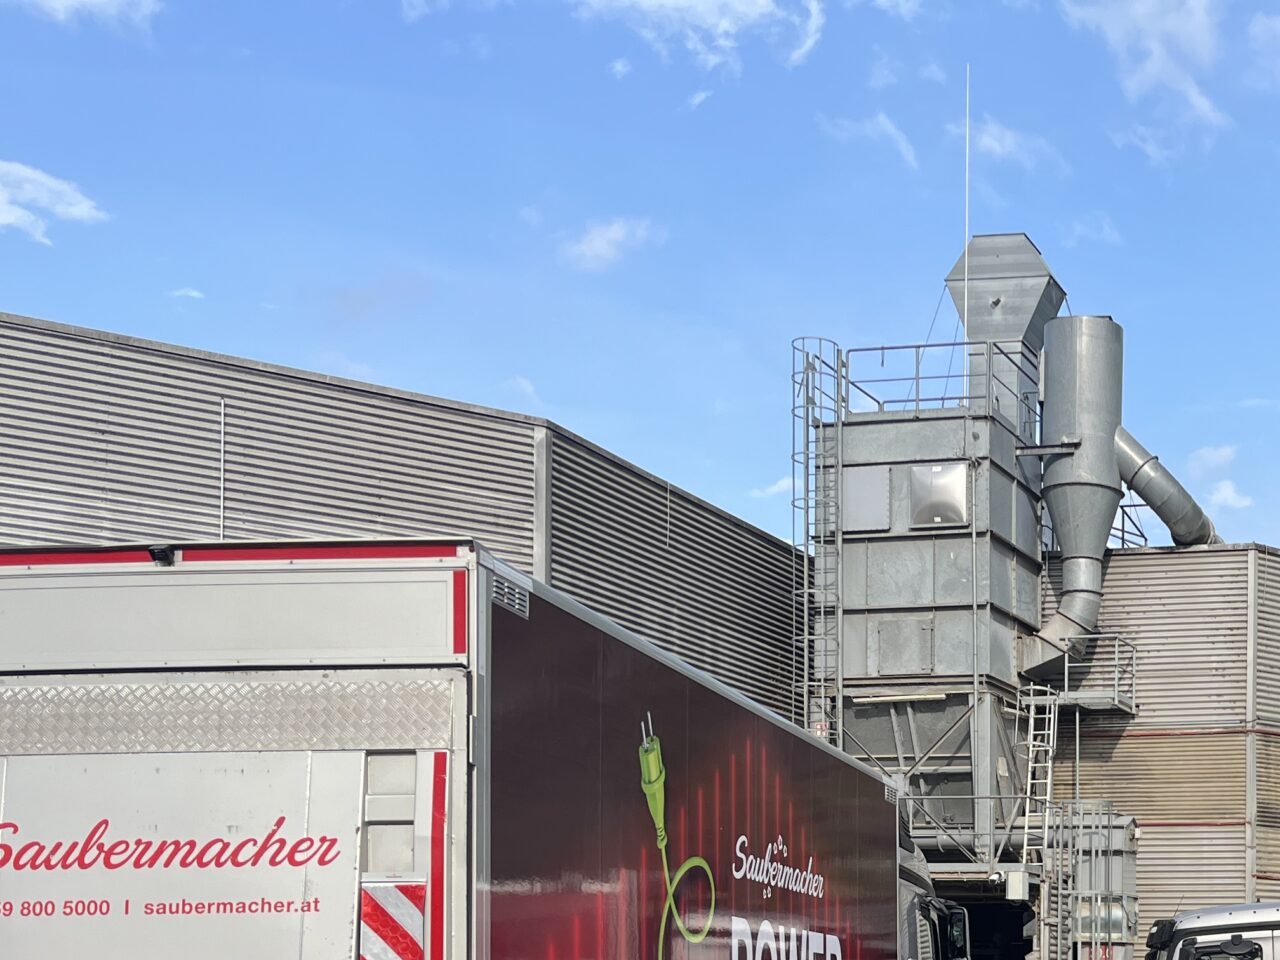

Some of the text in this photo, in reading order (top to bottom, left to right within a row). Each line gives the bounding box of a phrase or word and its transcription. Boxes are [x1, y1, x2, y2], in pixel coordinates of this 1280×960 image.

[732, 835, 824, 898] Saubermacher
[20, 900, 55, 917] 800
[62, 899, 110, 916] 5000
[143, 897, 321, 916] saubermacher.at
